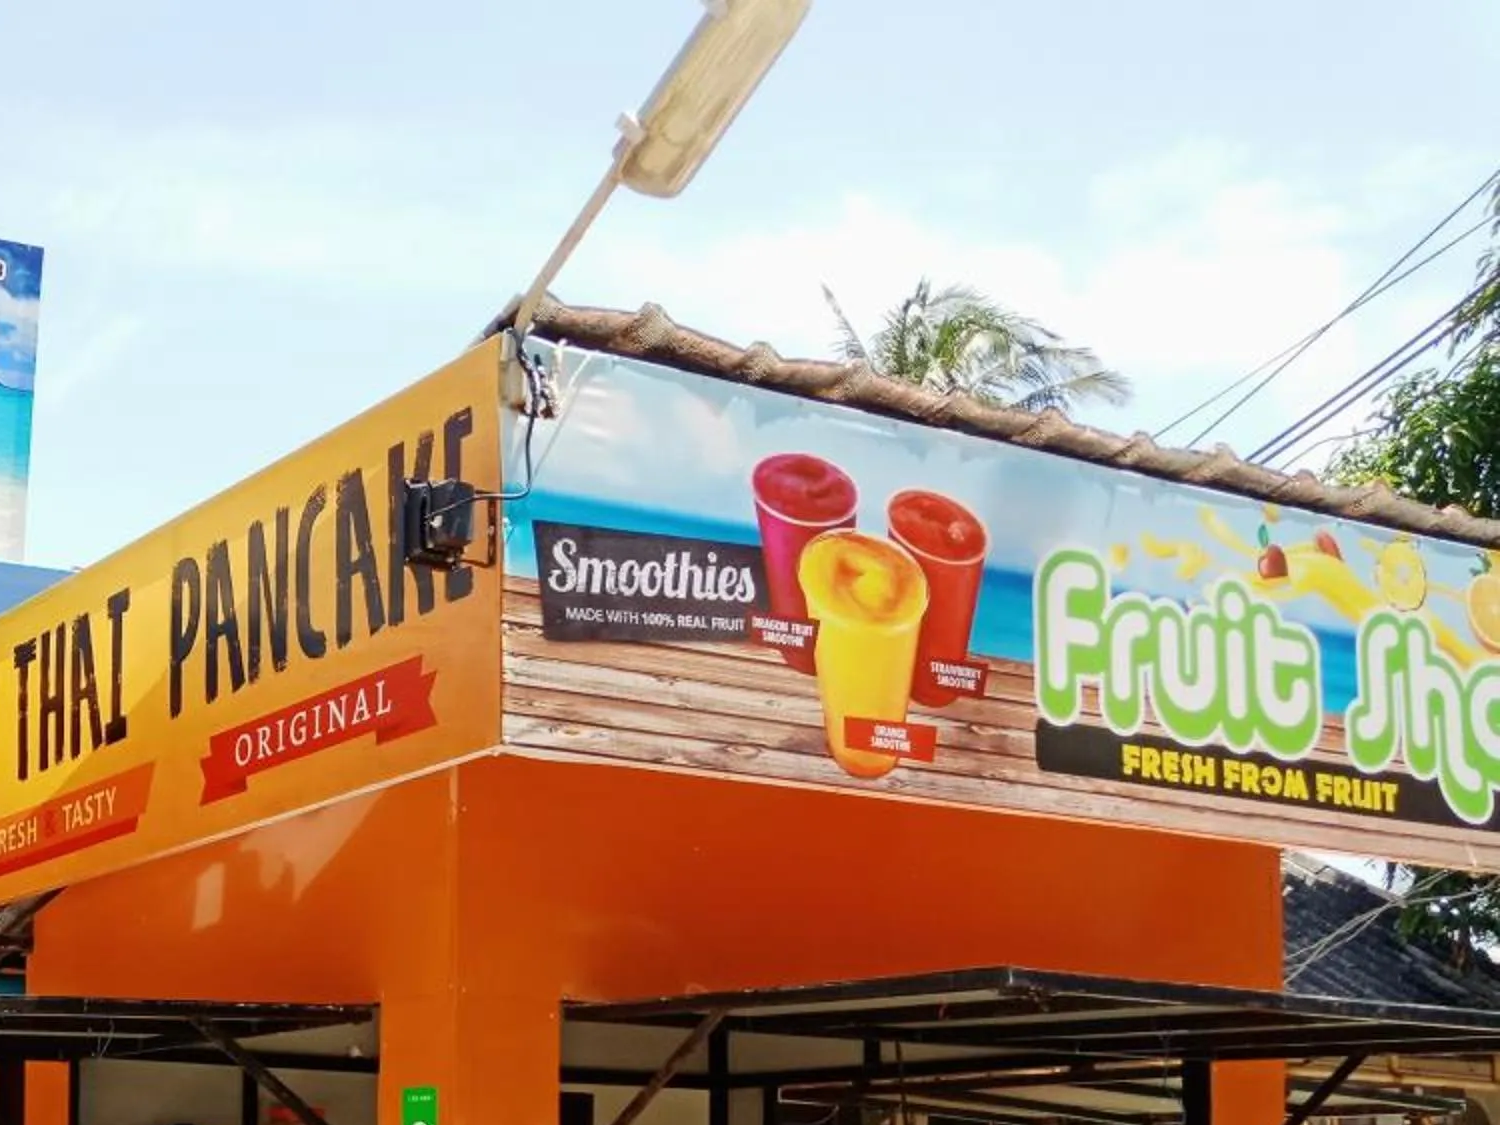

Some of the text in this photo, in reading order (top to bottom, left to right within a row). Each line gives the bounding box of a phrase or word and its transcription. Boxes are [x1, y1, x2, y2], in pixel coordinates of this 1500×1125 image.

[13, 406, 474, 781] THAI PANCAKE
[548, 537, 756, 603] Smoothies
[565, 607, 746, 632] MADE WITH 100% REAL FRUIT
[1039, 551, 1317, 750] Fruit
[234, 680, 393, 768] ORIGINAL
[63, 786, 117, 834] TASTY
[1121, 743, 1399, 812] FRESH FROM FRUIT
